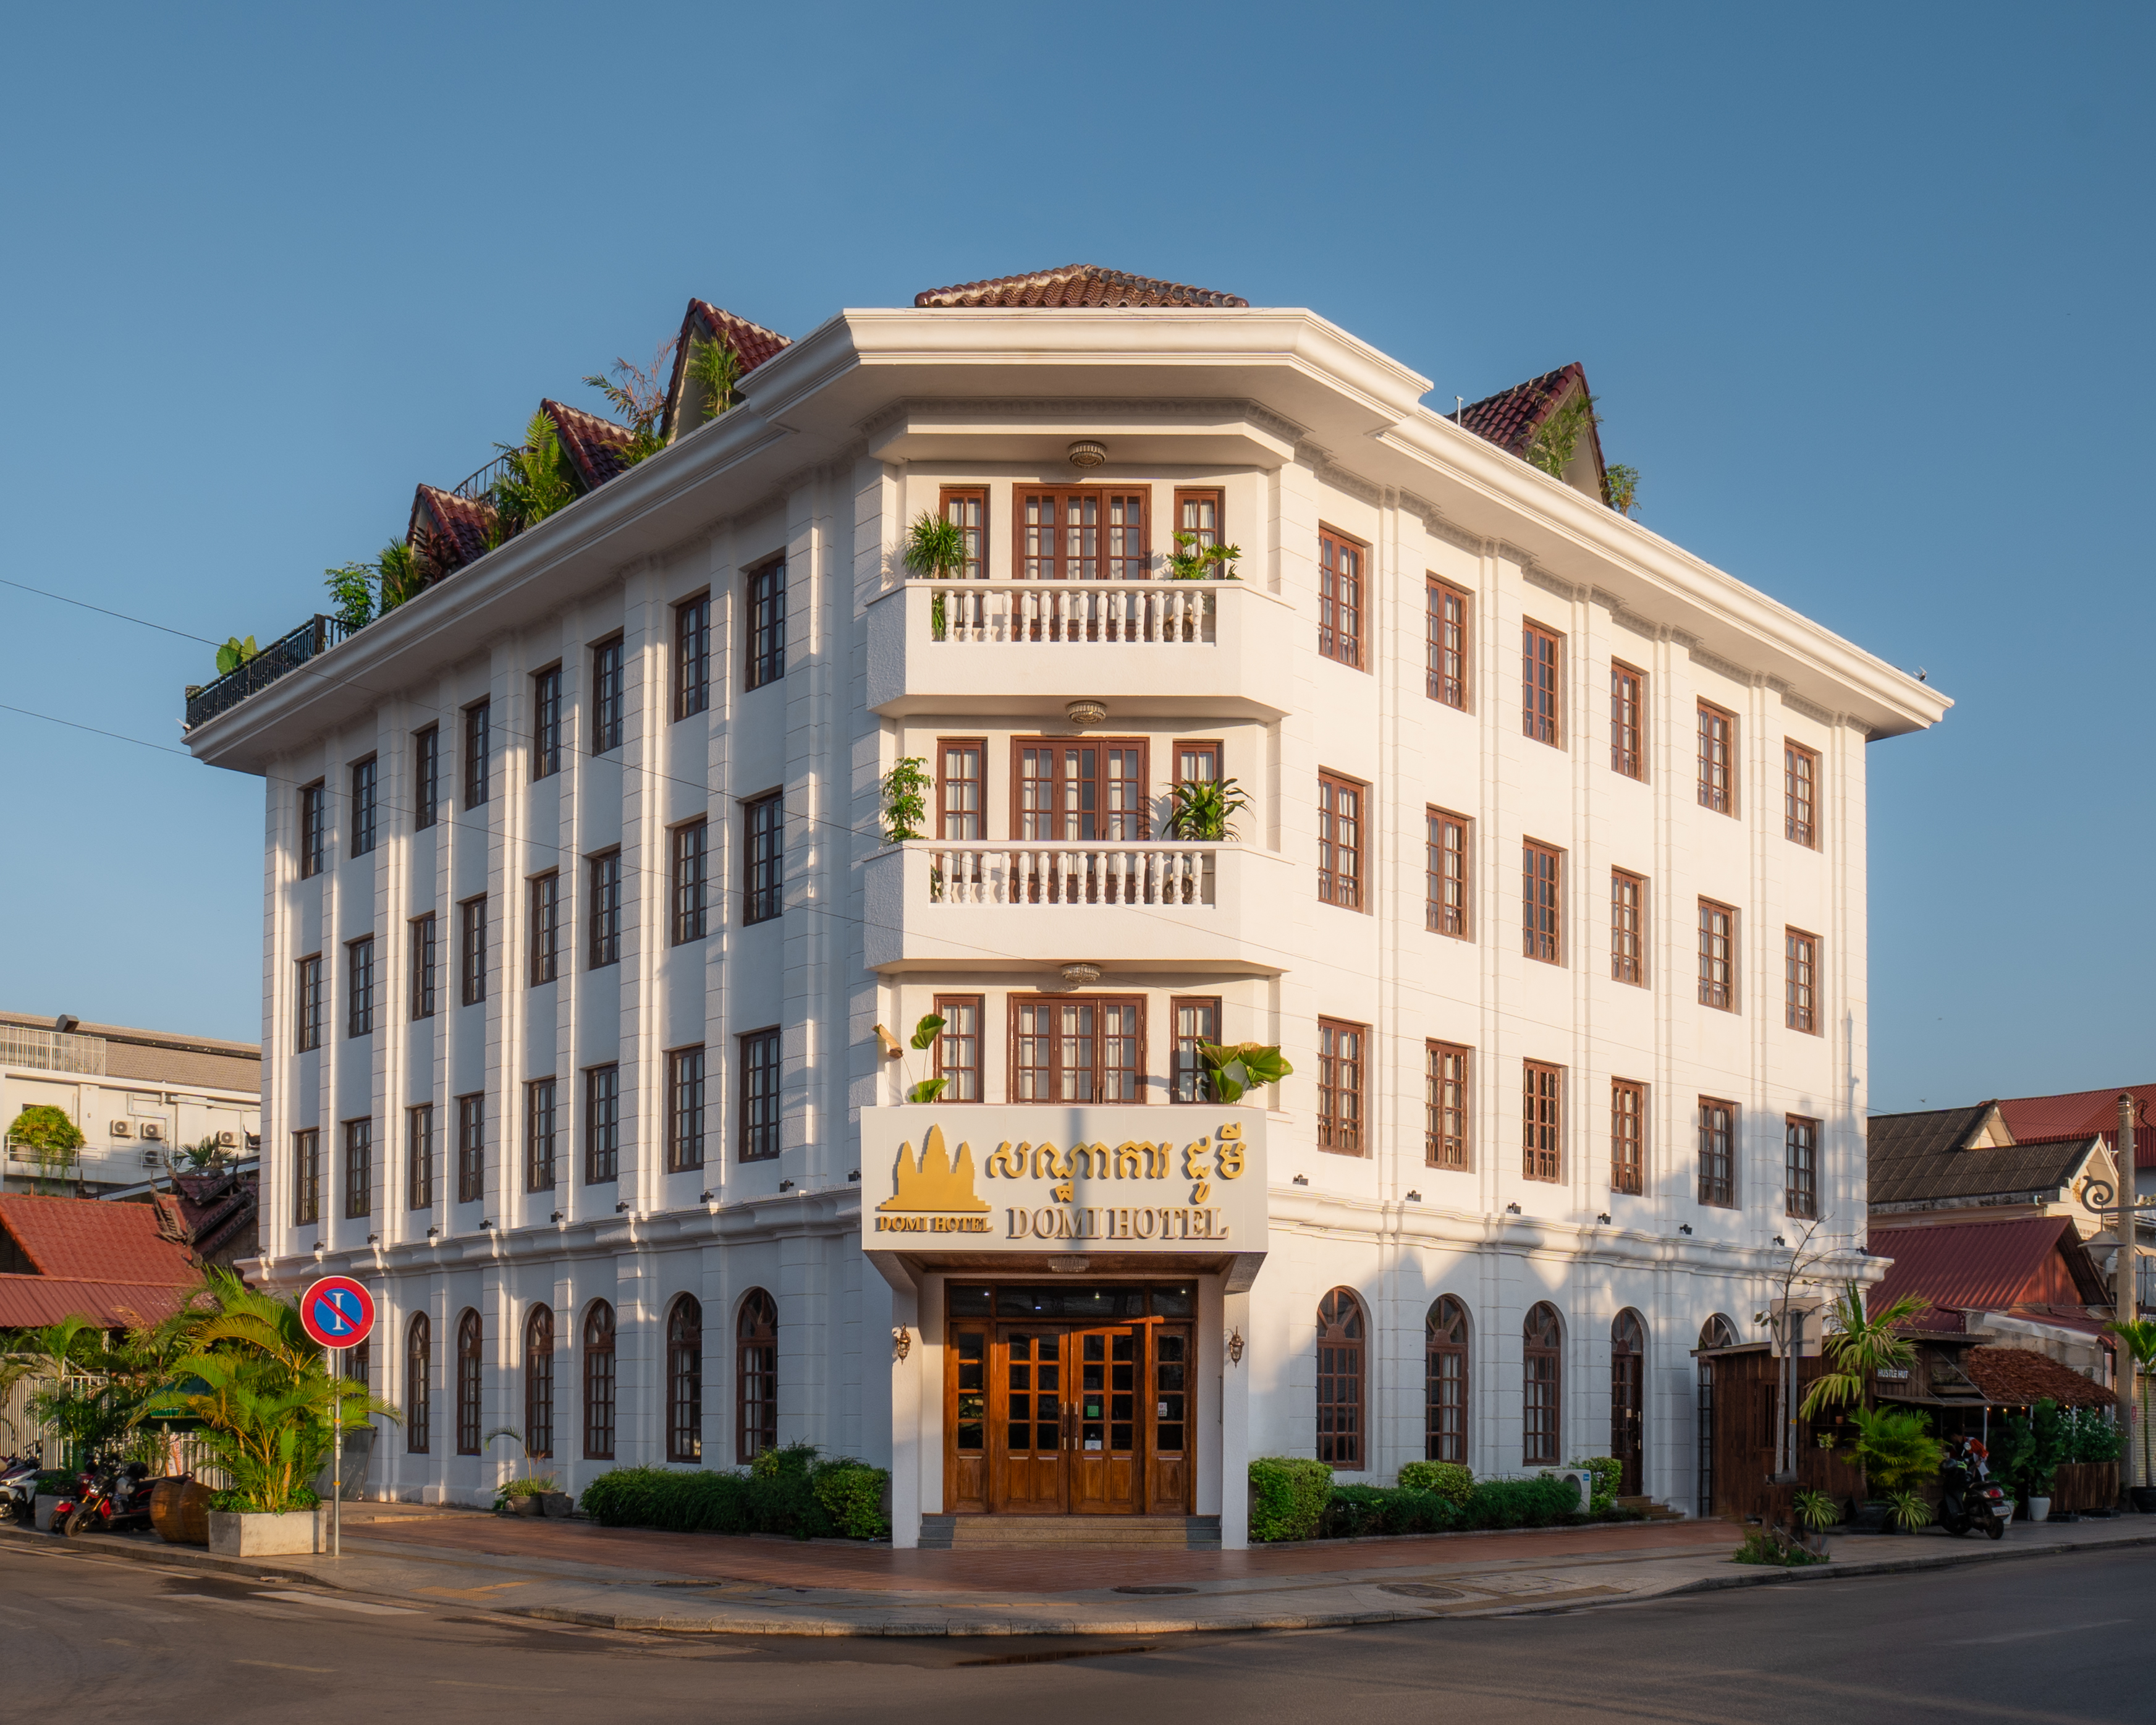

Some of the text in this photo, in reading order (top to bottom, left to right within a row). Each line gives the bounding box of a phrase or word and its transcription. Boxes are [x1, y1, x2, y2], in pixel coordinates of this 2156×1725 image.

[879, 1216, 993, 1232] DOMI HOTEL
[1010, 1206, 1229, 1240] DOMI HOTEL
[1898, 1370, 1908, 1379] HUT
